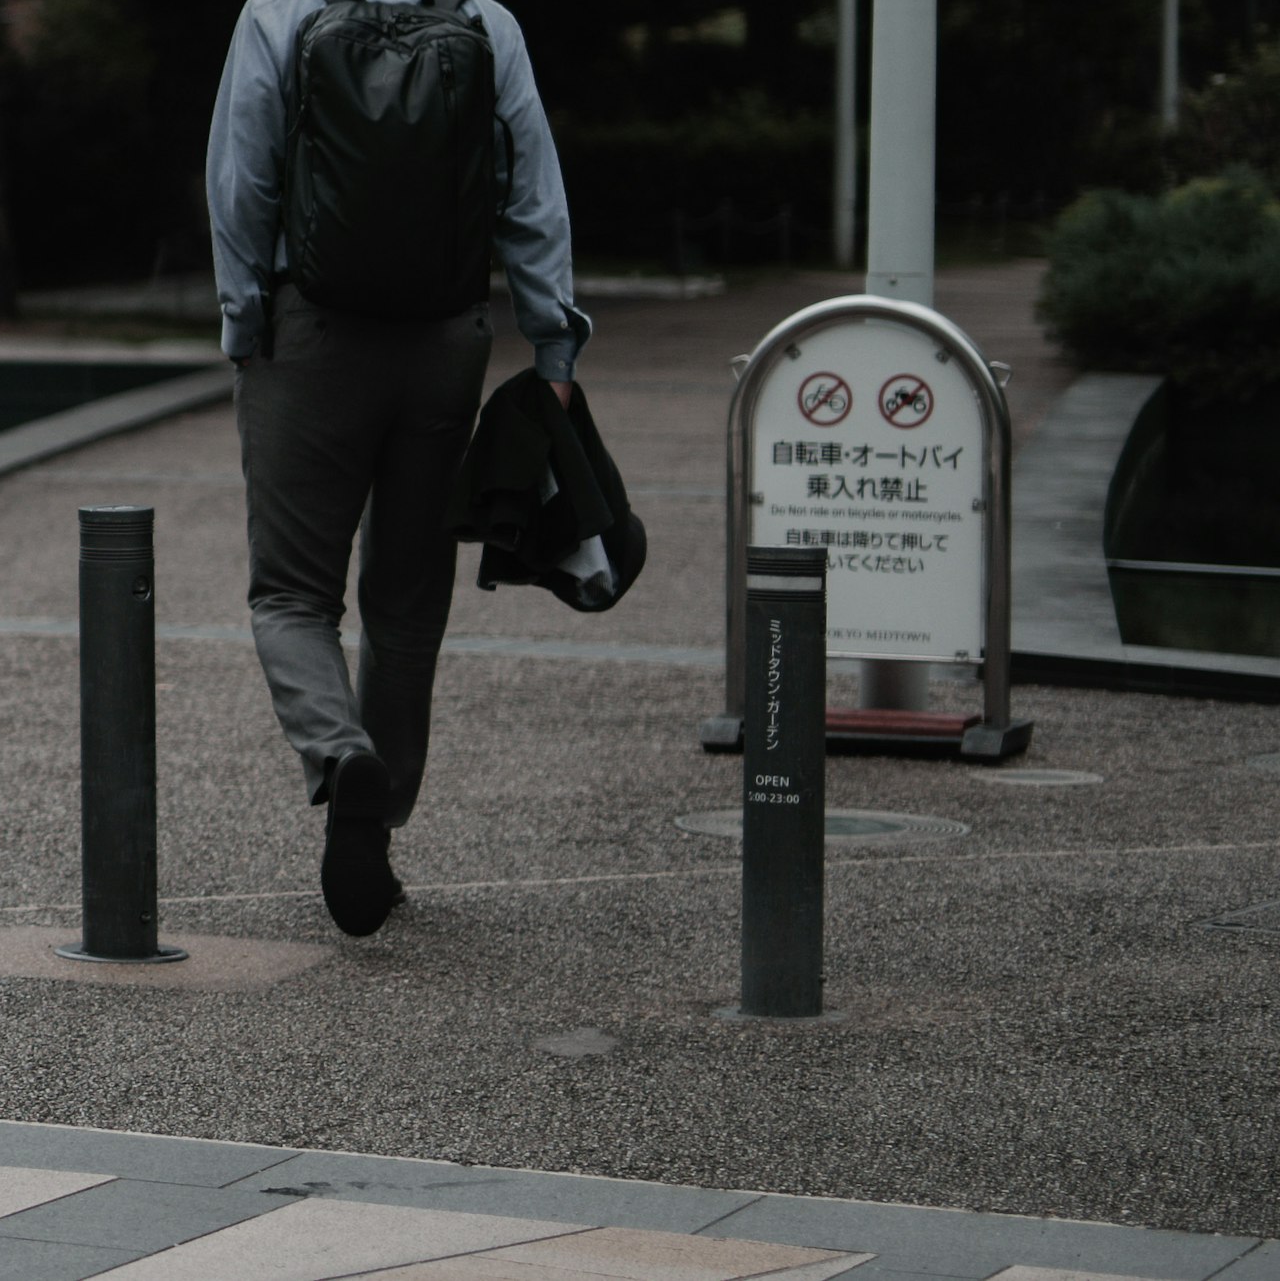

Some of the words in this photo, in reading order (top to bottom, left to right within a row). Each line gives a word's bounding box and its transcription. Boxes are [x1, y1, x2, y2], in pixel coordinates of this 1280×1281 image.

[773, 440, 964, 470] 自転車・オートバイ
[807, 474, 928, 503] 乗入れ禁止
[771, 504, 785, 516] Do
[788, 505, 806, 517] Not
[810, 506, 829, 518] ride
[832, 508, 845, 518] on
[848, 508, 885, 521] bicycles
[888, 510, 899, 519] or
[786, 529, 949, 552] 自転車は降りて押して
[827, 554, 925, 573] いてください
[827, 627, 862, 640] OKYO
[865, 630, 932, 643] MIDTOWN
[766, 619, 782, 751] ミッドタウン・ガーデン
[755, 774, 790, 788] OPEN
